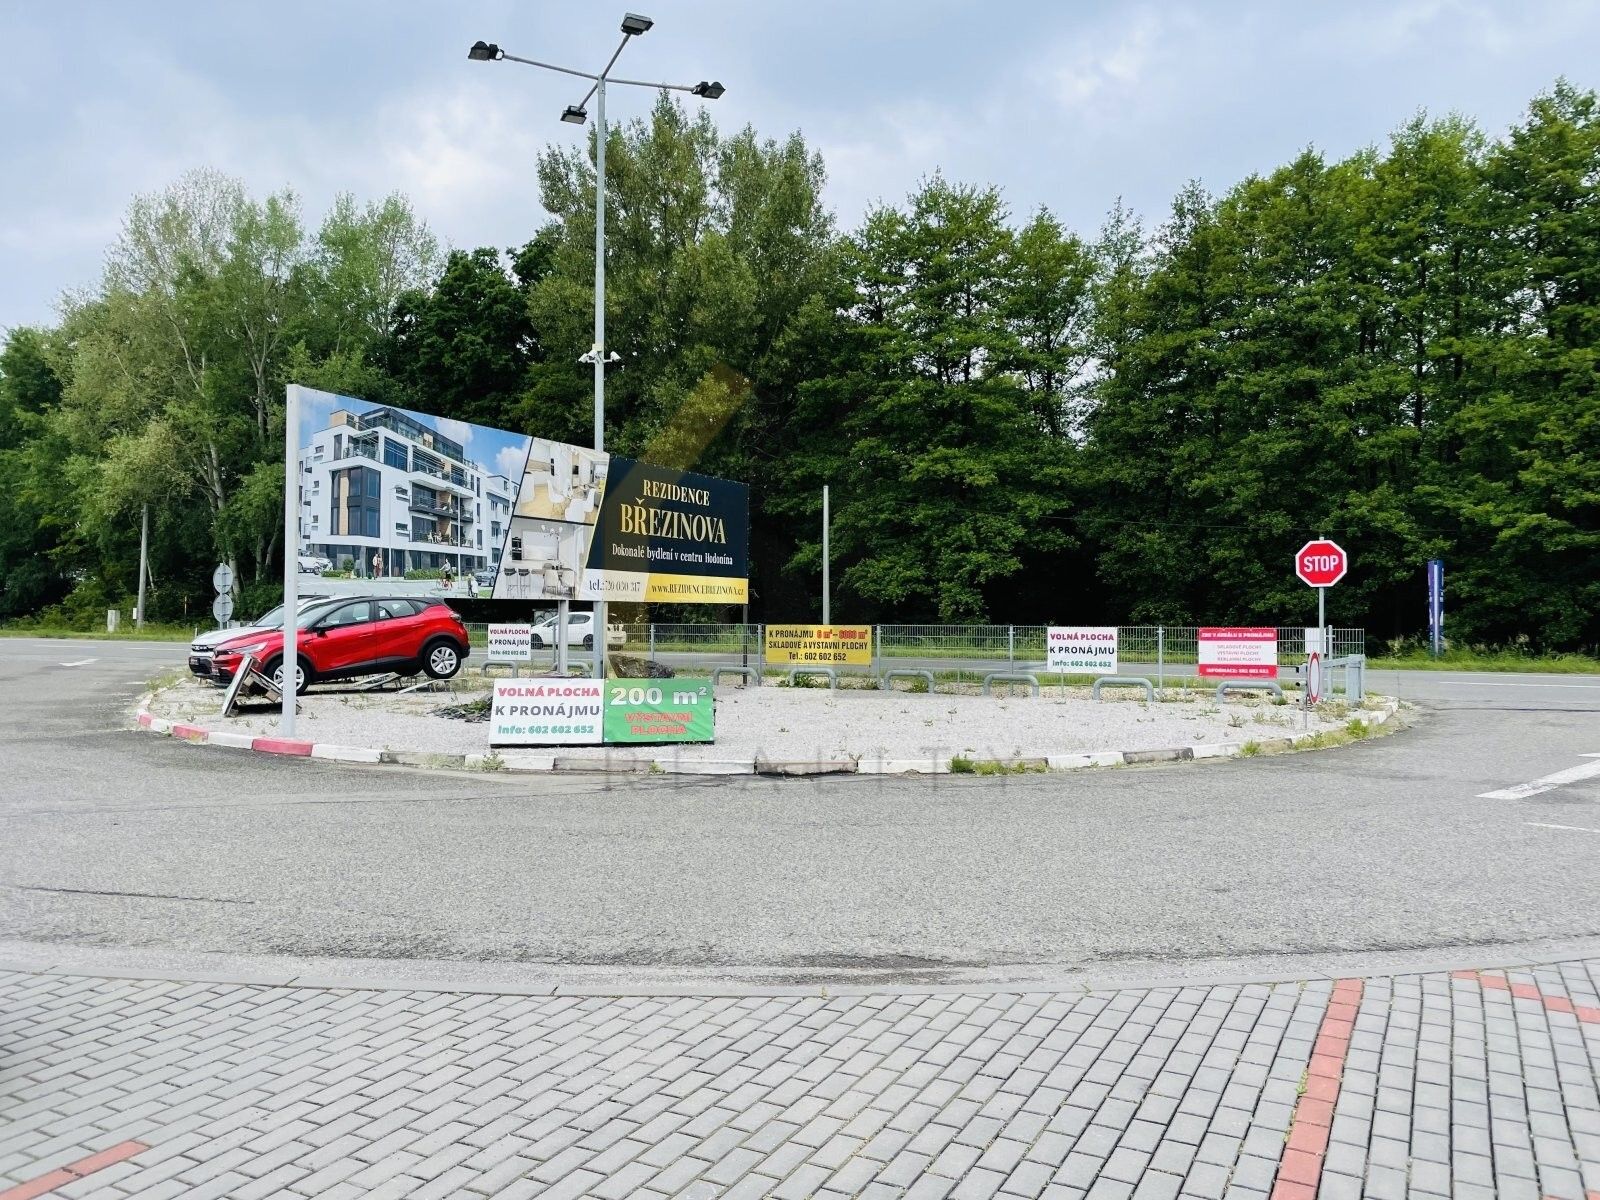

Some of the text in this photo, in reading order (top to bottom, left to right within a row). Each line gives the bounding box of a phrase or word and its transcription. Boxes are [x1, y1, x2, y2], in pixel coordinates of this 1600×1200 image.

[643, 479, 710, 507] REZIDENCE
[620, 497, 727, 544] BŘEZINOVA
[612, 543, 733, 565] Dokonalé bydlení v centru Hodonína
[1303, 555, 1340, 572] STOP
[769, 630, 774, 638] K
[1050, 632, 1079, 640] VOLNÁ
[842, 642, 868, 650] PLOCHY
[1058, 645, 1115, 656] PRONÁJMU
[789, 652, 802, 660] Tel.:
[804, 652, 817, 660] 602
[833, 653, 846, 661] 652
[498, 685, 600, 697] VOLNÁ PLOCHA
[610, 686, 707, 705] 200 m²
[495, 702, 600, 718] K PRONÁJMU
[528, 725, 549, 735] 602
[551, 725, 572, 735] 602
[573, 726, 594, 735] 652
[631, 724, 687, 735] PLOCHA
